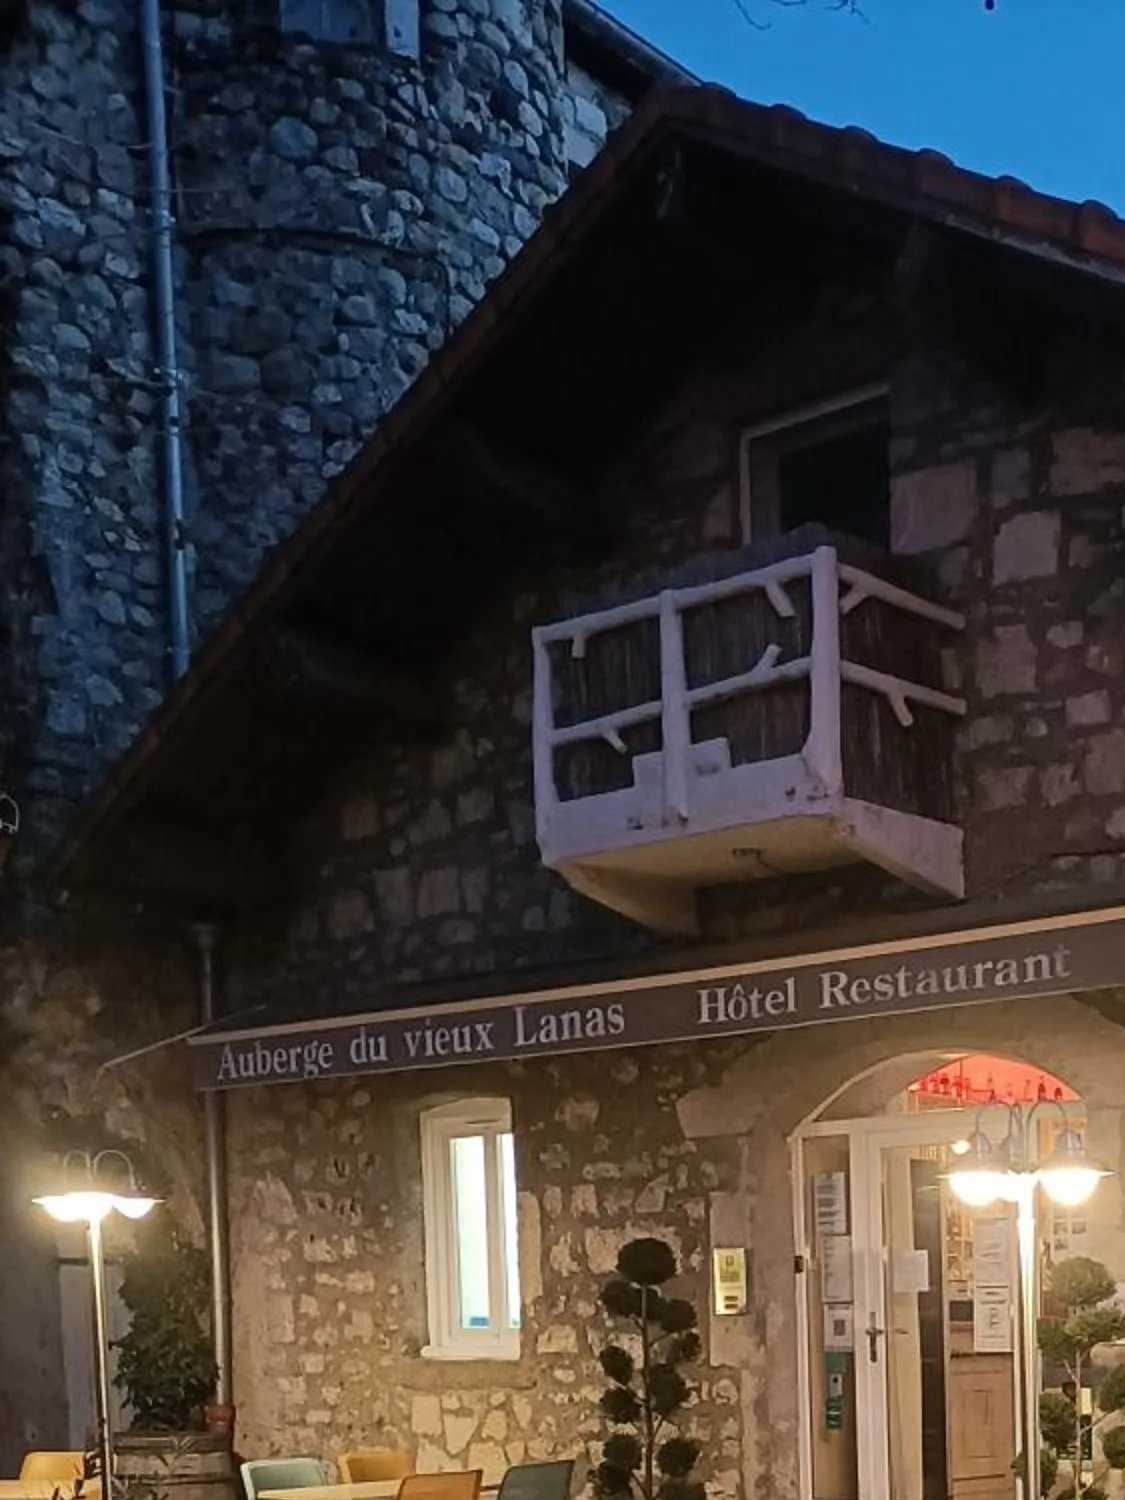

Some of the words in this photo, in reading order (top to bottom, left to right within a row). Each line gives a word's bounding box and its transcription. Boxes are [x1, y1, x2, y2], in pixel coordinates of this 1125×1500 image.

[217, 1041, 333, 1081] Auberge
[348, 1025, 388, 1064] du
[404, 1017, 494, 1058] vieux
[513, 1002, 626, 1047] Lanas
[696, 978, 798, 1025] Hôtel
[818, 942, 1072, 1011] Restaurant
